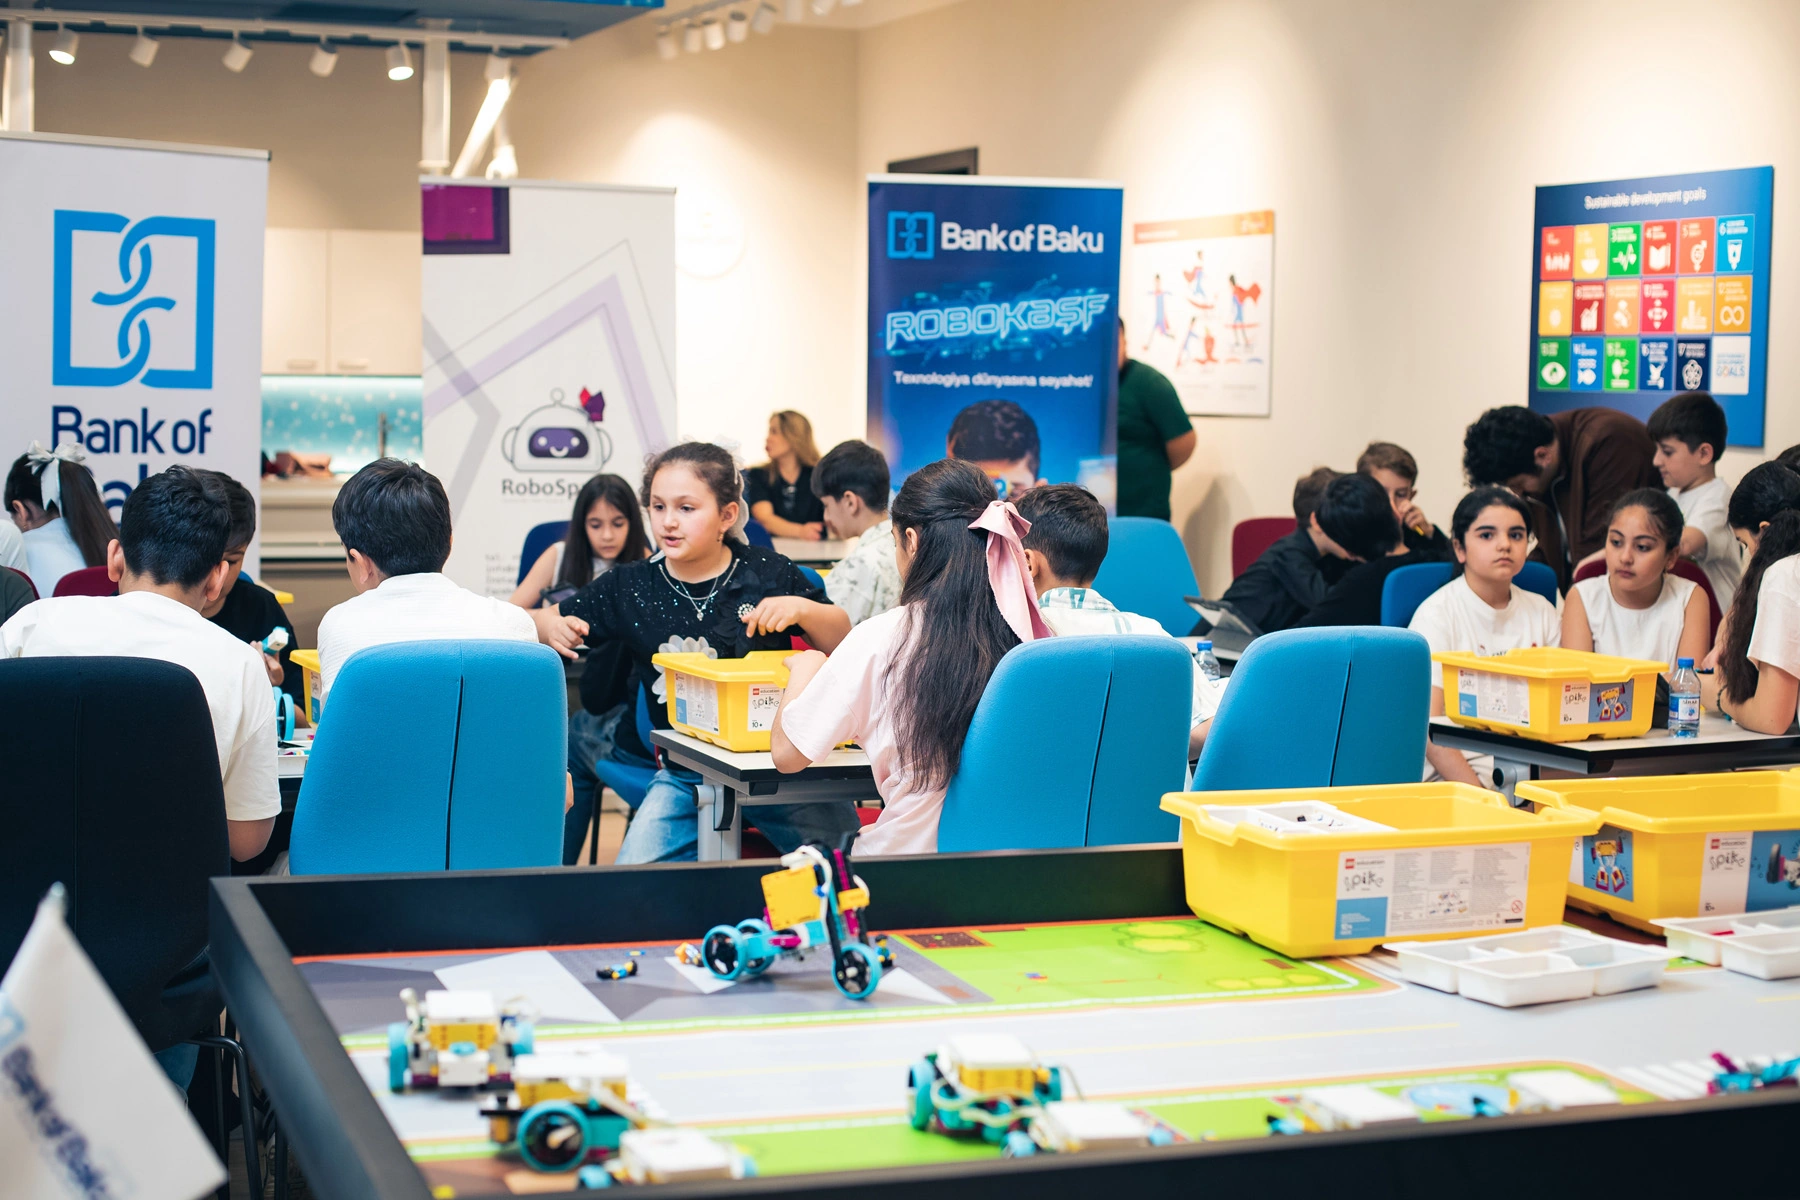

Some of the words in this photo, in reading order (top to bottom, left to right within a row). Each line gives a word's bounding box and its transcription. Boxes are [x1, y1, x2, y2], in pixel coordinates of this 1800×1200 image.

[1584, 192, 1630, 210] Sustainable
[1630, 189, 1682, 207] development
[1682, 186, 1708, 205] goals
[941, 221, 1009, 252] Bank
[1009, 223, 1035, 252] of
[1037, 224, 1104, 254] Baku
[893, 370, 970, 388] Texnologiya
[52, 405, 165, 454] Bank
[172, 408, 212, 454] of
[502, 478, 582, 499] RoboSp
